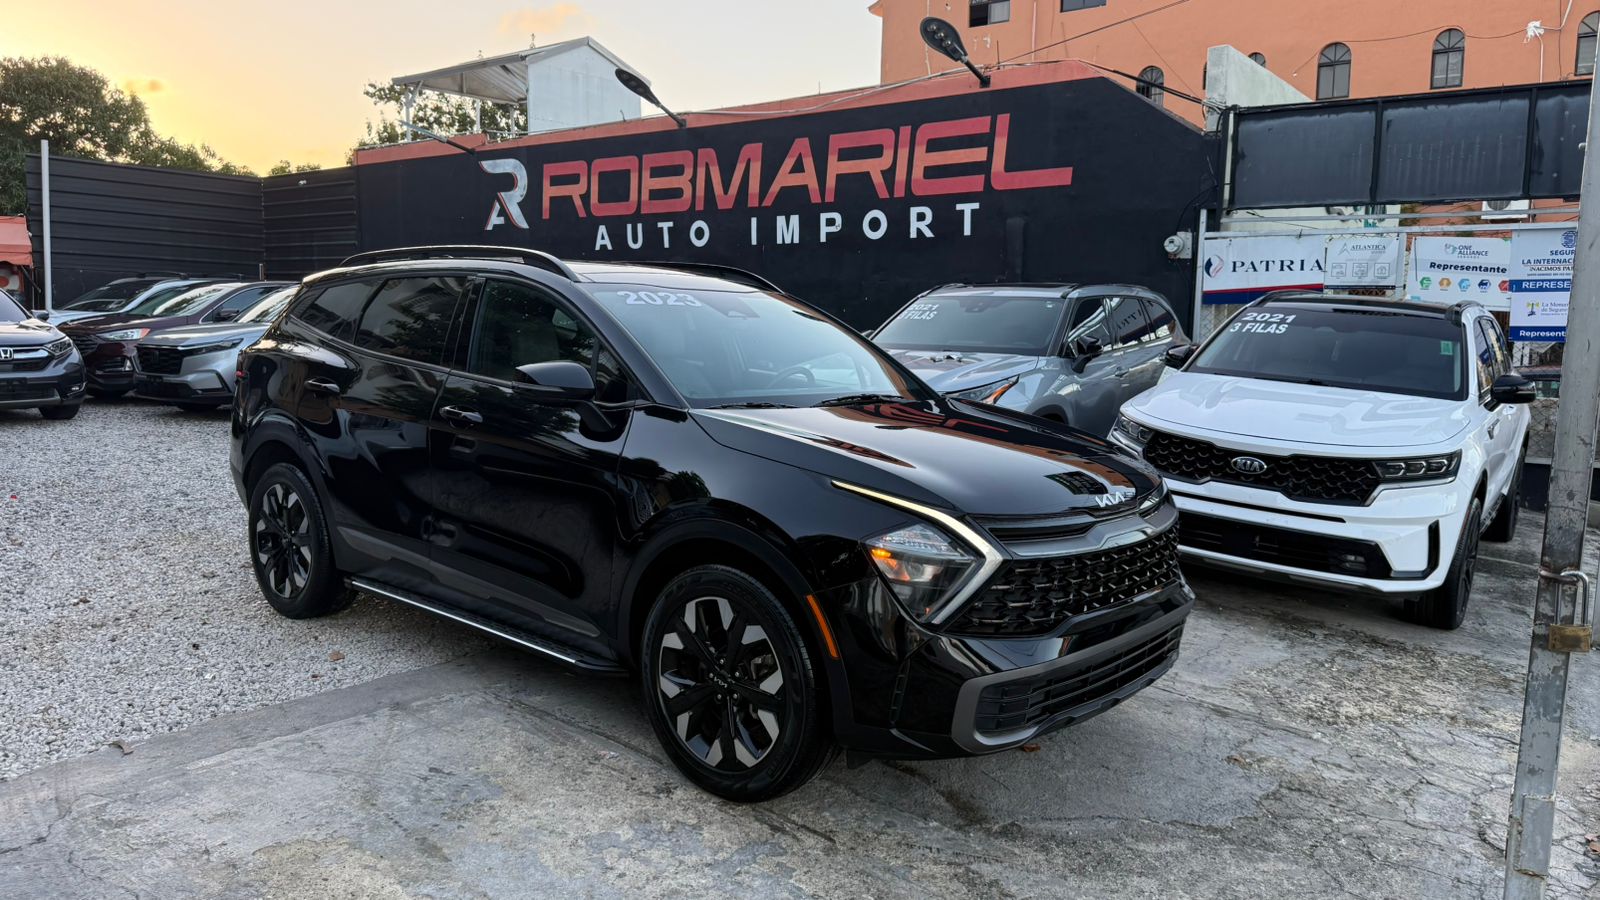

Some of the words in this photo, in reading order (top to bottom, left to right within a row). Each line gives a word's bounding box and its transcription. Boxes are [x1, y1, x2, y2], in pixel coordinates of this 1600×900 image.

[542, 113, 1073, 220] ROBMARIEL
[595, 219, 710, 251] AUTO
[751, 202, 980, 246] IMPORT
[1231, 258, 1324, 273] PATRIA
[1429, 261, 1508, 274] Representante
[1522, 281, 1572, 290] REPRESE
[616, 290, 702, 307] 2023
[1241, 312, 1297, 323] 2021
[1229, 322, 1242, 333] 3
[1242, 322, 1289, 334] FILAS
[1235, 459, 1261, 472] KIA
